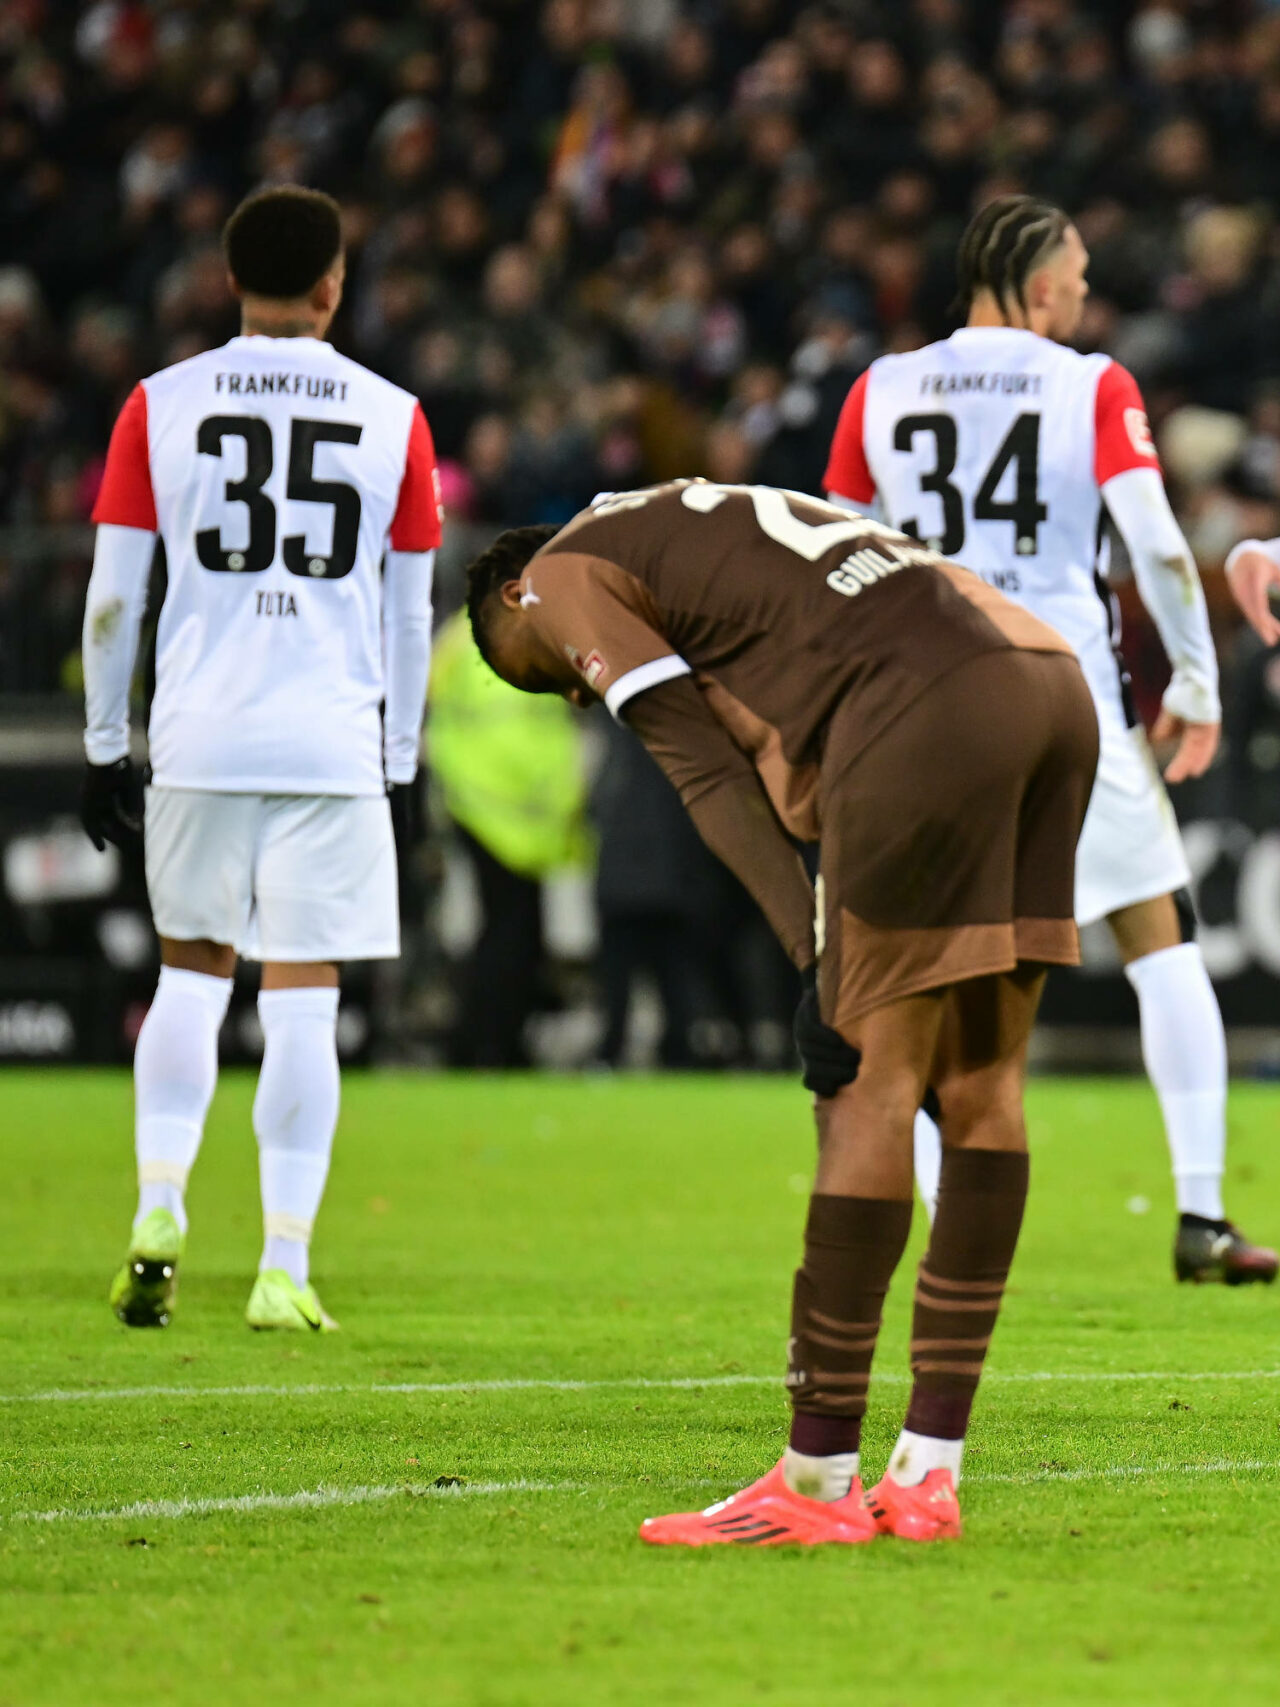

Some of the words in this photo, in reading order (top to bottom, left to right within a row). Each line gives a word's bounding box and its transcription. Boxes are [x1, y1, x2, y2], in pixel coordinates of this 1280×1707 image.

[215, 371, 349, 401] FRANKFURT
[919, 371, 1042, 396] FRANKFURT
[194, 414, 363, 580] 35
[893, 410, 1047, 556] 34
